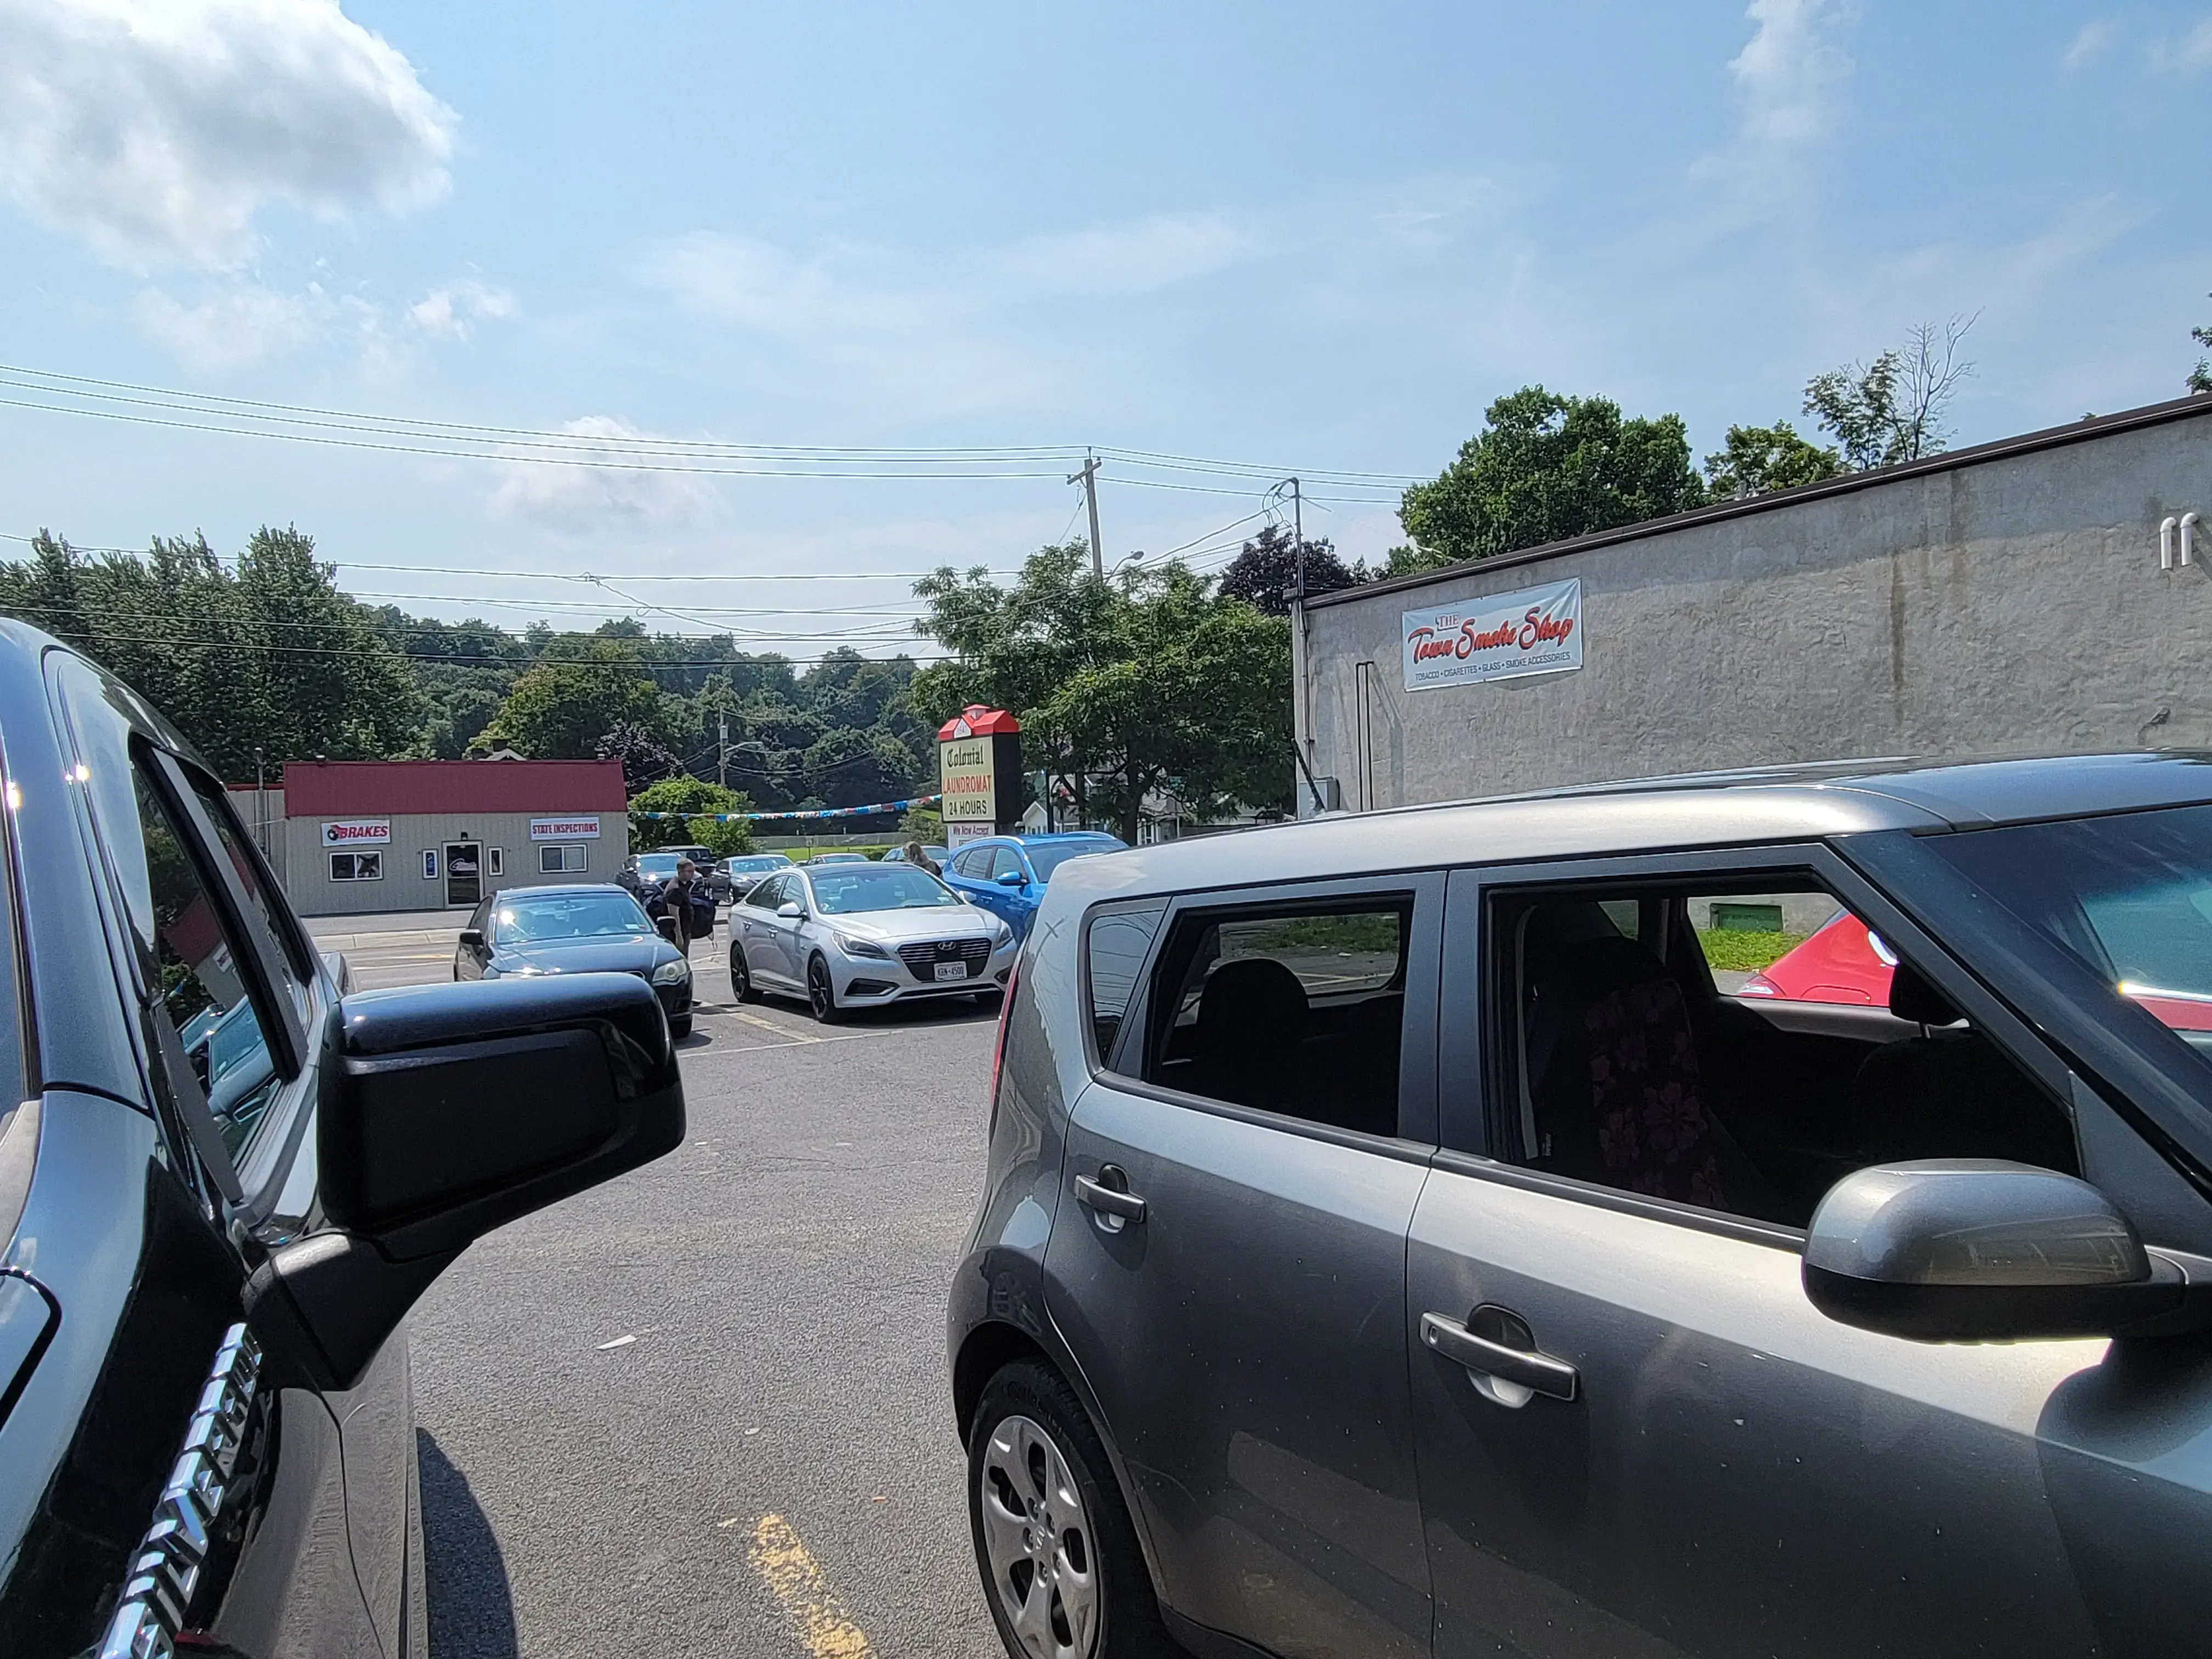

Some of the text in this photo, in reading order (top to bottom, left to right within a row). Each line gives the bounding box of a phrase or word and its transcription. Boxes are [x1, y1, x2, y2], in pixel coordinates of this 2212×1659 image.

[1437, 614, 1459, 628] THE
[1407, 606, 1574, 665] Town Smoke Shop
[1415, 651, 1571, 681] TOBACCO CIGARETTES GLASS SMOKE ACCESSORIES
[947, 746, 984, 768] Colonial
[943, 775, 991, 794] LAUNDROMAT
[949, 800, 987, 816] 24 HOURS
[337, 825, 388, 839] BRAKES
[532, 823, 597, 834] STATE INSPECTIONS
